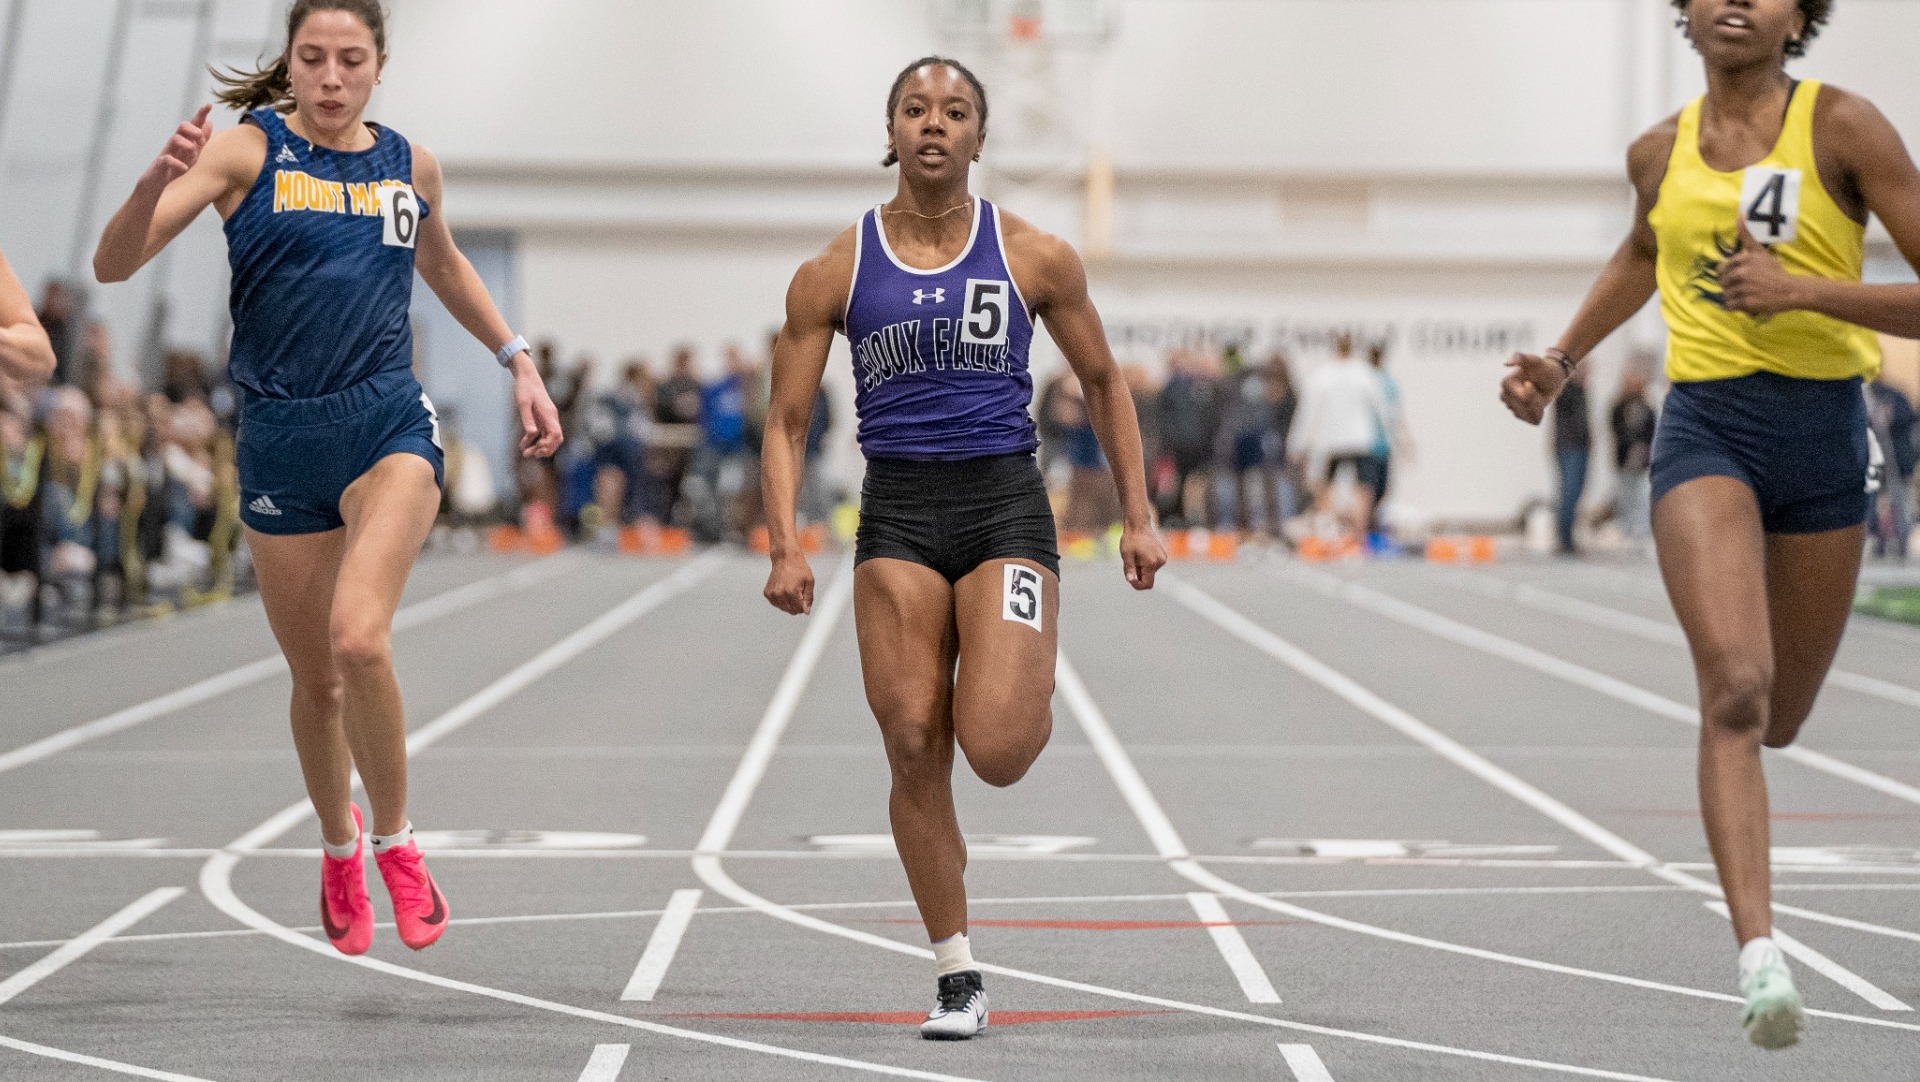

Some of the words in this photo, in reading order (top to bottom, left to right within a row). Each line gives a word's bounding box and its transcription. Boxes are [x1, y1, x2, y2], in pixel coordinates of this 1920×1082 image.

[273, 169, 346, 214] MOUNT
[392, 190, 414, 243] 6
[1747, 173, 1787, 237] 4
[968, 283, 1001, 339] 5
[857, 319, 927, 392] SIOUX
[1009, 568, 1036, 620] 5
